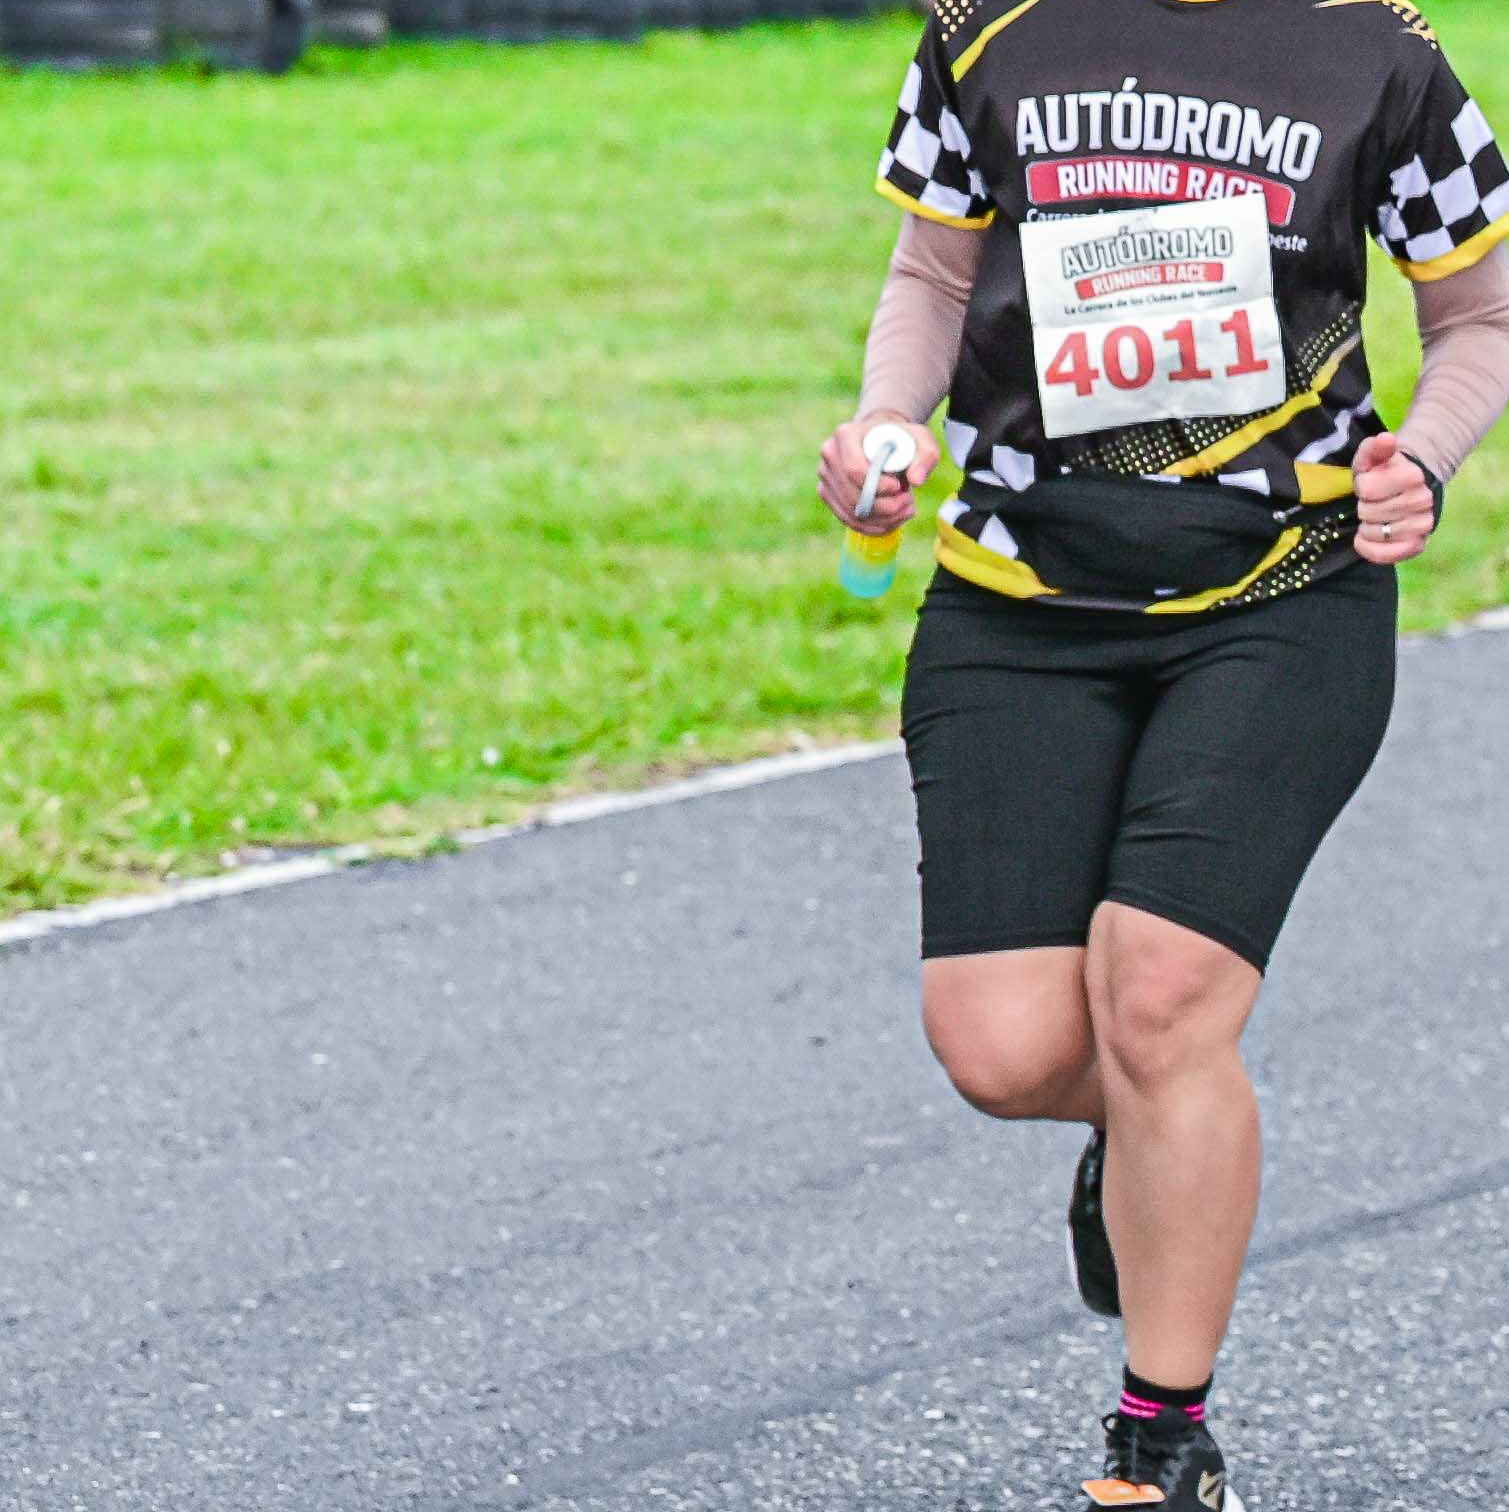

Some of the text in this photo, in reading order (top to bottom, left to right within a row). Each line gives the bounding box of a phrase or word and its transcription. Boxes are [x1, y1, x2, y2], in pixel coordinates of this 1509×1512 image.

[1016, 76, 1322, 182] AUTÓDROMO
[1056, 161, 1180, 199] RUNNING
[1061, 225, 1235, 280] AUTÓDROMO
[1092, 264, 1208, 296] RUNNING RACE
[1044, 309, 1270, 397] 4011
